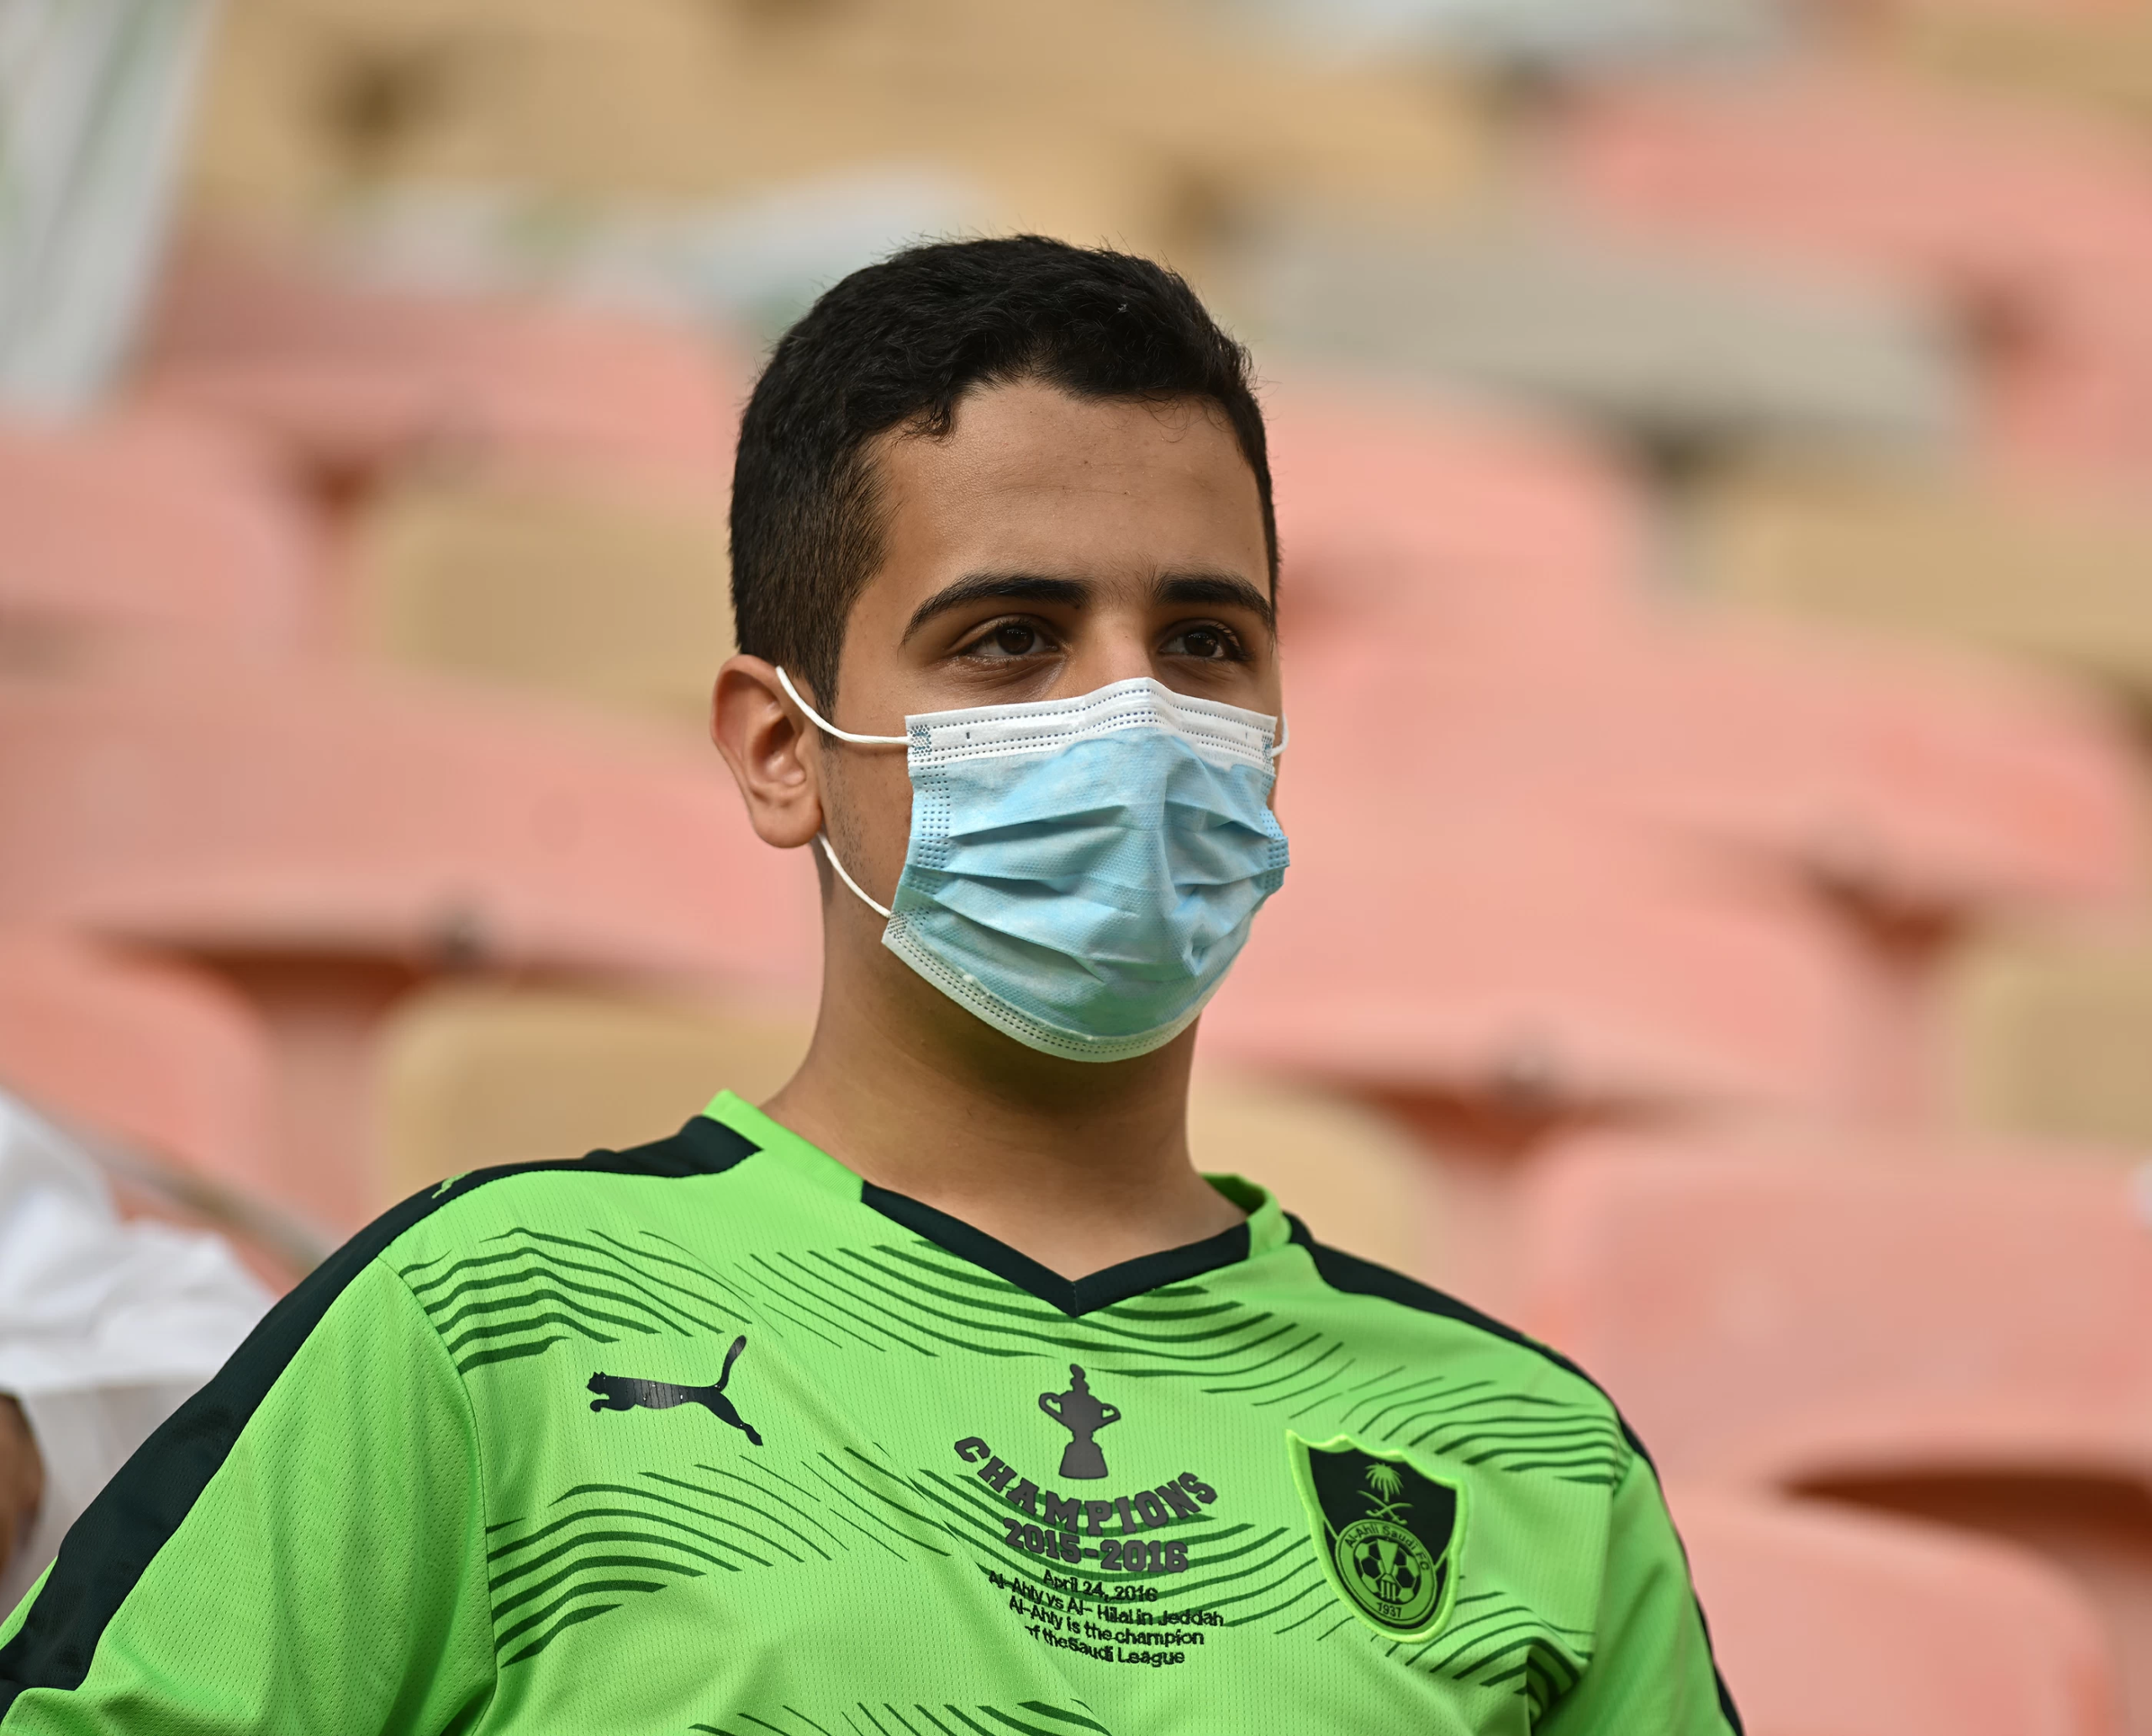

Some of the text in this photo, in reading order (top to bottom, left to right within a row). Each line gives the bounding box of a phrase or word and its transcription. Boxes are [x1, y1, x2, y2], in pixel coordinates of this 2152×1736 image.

[954, 1436, 1218, 1536] CHAMPIONS
[1003, 1517, 1189, 1573] 2015-2016
[1345, 1523, 1430, 1570] Al-Ahli Saudi FC
[989, 1570, 1044, 1605] Al-Ahly
[1137, 1608, 1153, 1626] in
[1158, 1609, 1224, 1626] Jeddah
[1043, 1569, 1079, 1592] April
[1114, 1585, 1158, 1601] 2016
[1376, 1601, 1402, 1618] 1937
[1010, 1596, 1205, 1648] Al-Ahly is the champion
[1118, 1647, 1185, 1668] League
